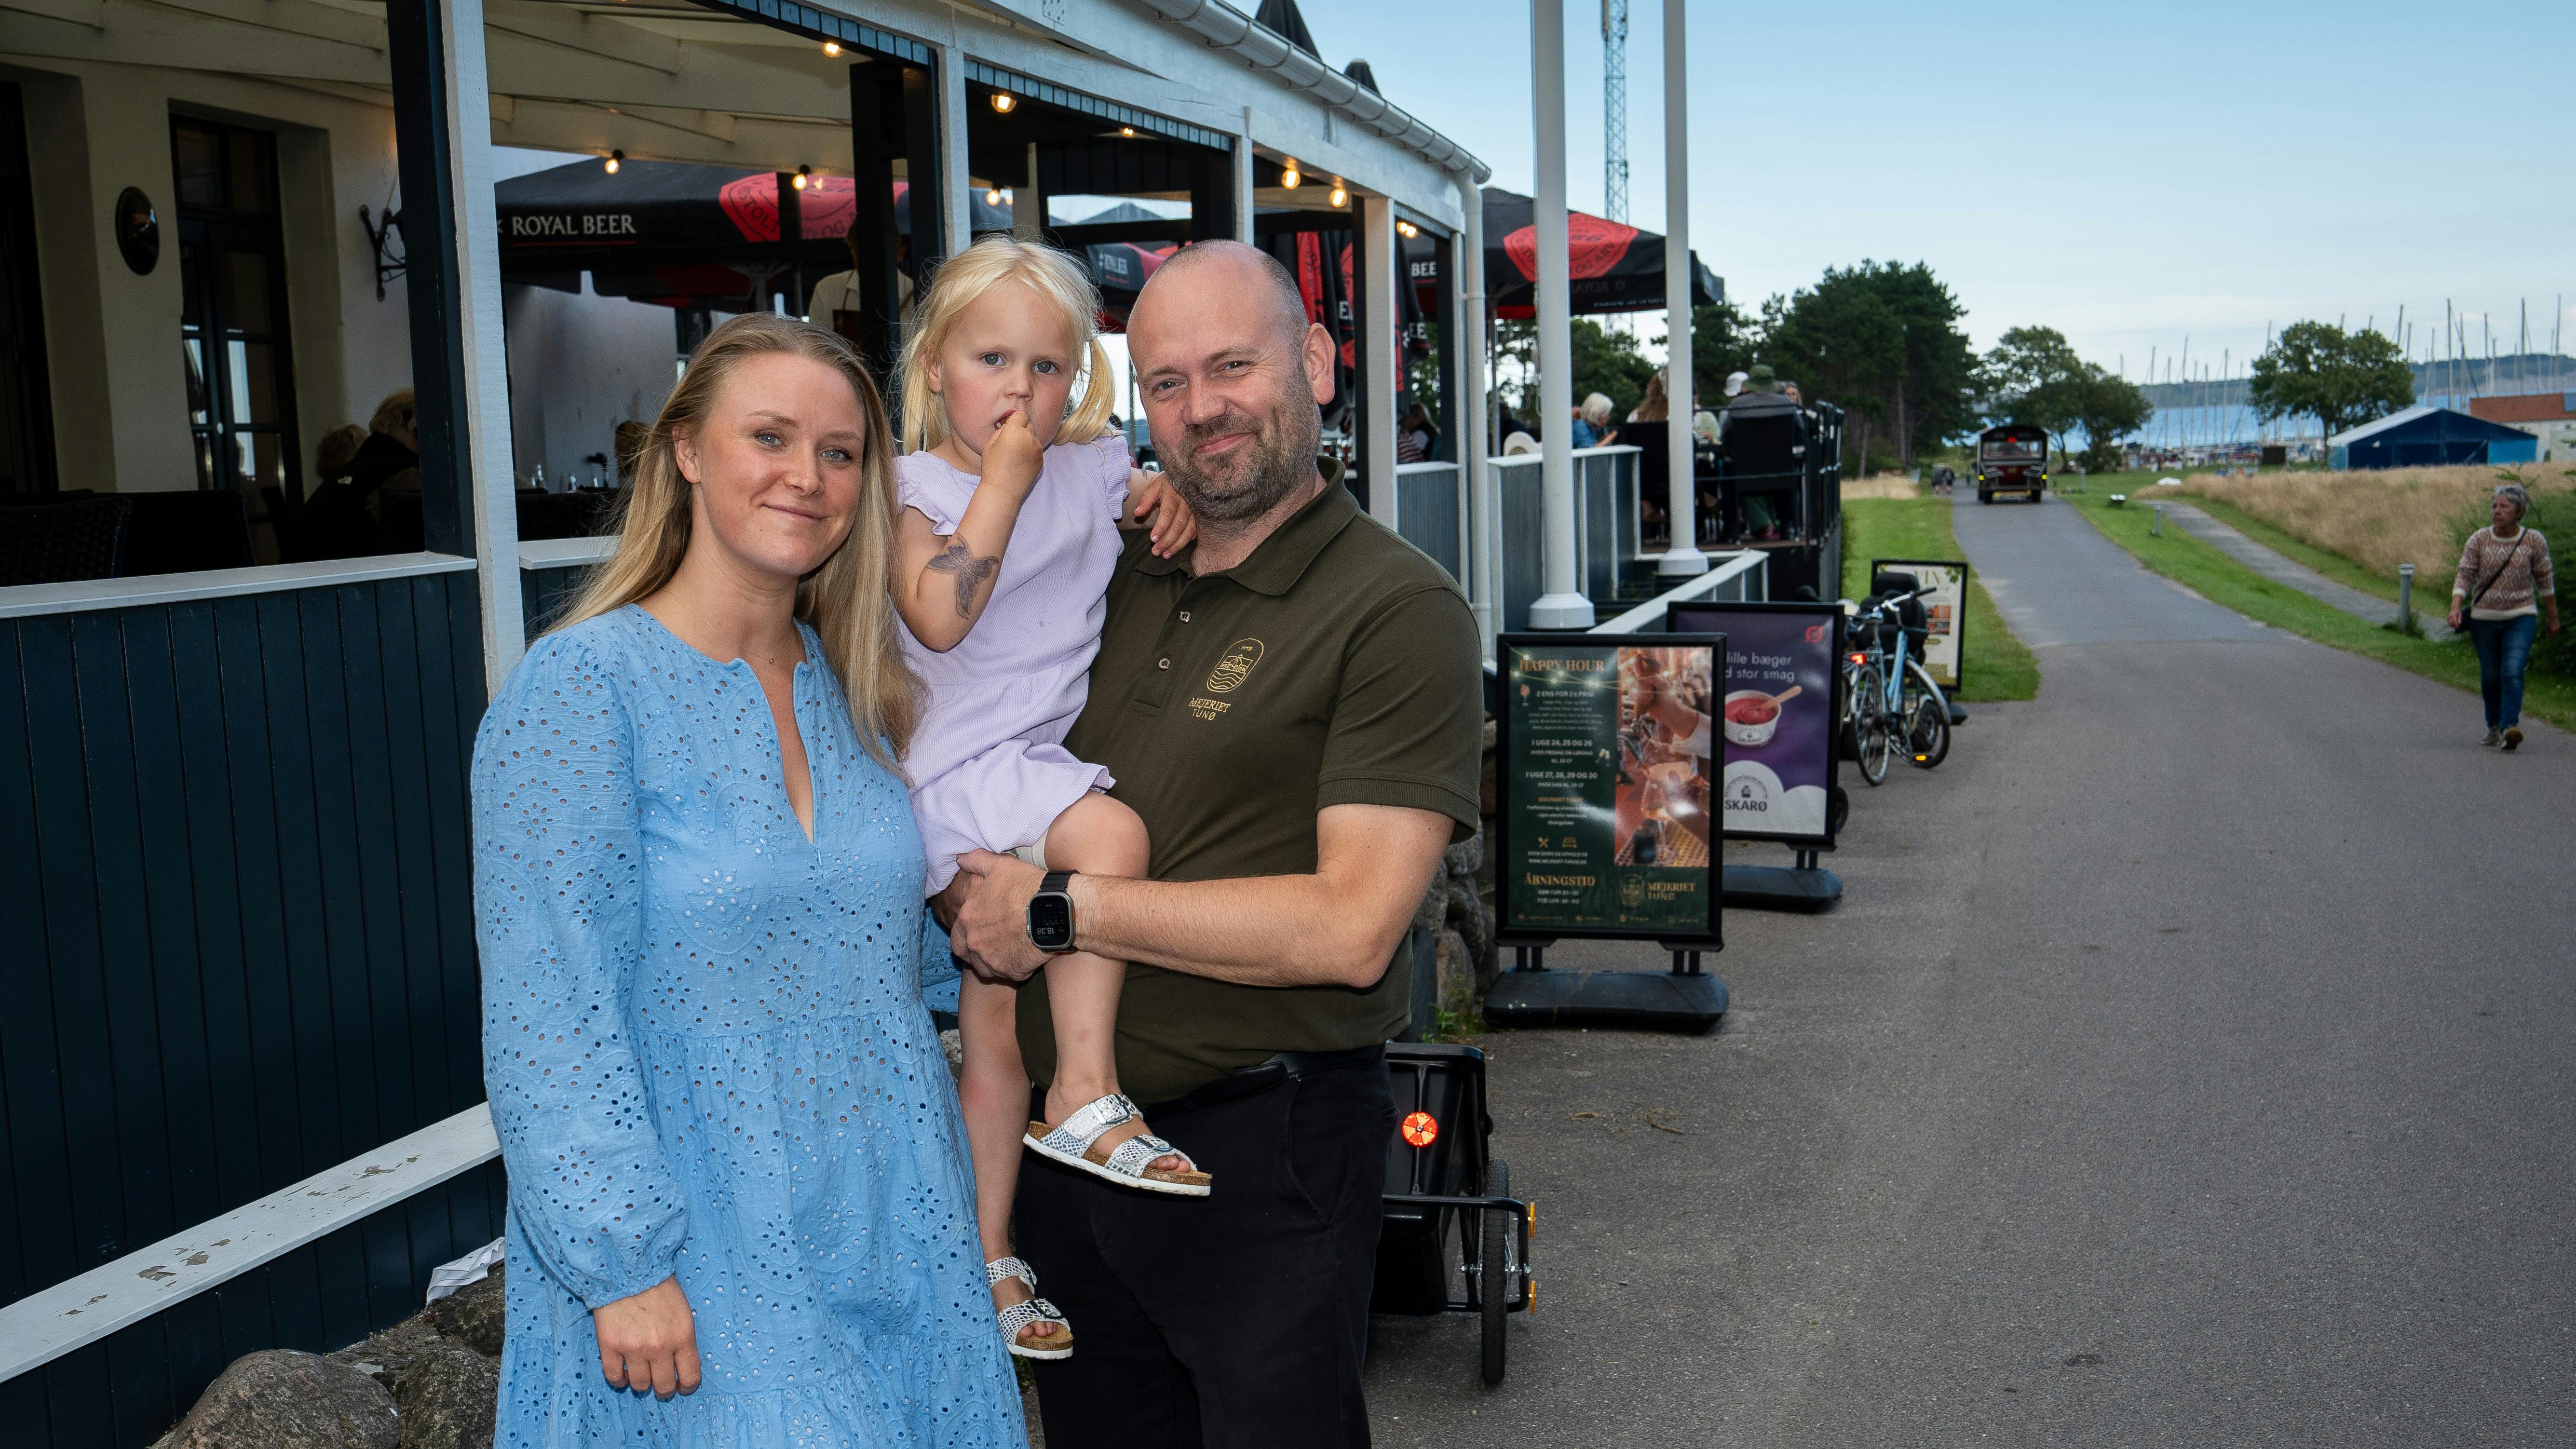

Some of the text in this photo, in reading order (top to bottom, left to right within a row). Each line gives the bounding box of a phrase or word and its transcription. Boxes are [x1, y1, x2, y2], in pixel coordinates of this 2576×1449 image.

[512, 215, 637, 236] ROYAL BEER
[1411, 261, 1437, 277] BEE
[1519, 659, 1604, 672] HAPPY HOUR
[1752, 652, 1792, 668] bæger
[1736, 668, 1759, 679] stor
[1763, 670, 1795, 683] smag
[1188, 697, 1231, 713] MEJERIET
[1192, 709, 1216, 720] TUNØ
[1725, 799, 1767, 812] SKARØ
[1525, 872, 1596, 886] ÅBNINGSTID
[1647, 882, 1696, 892] MEJERIET
[1648, 893, 1675, 901] TUNØ
